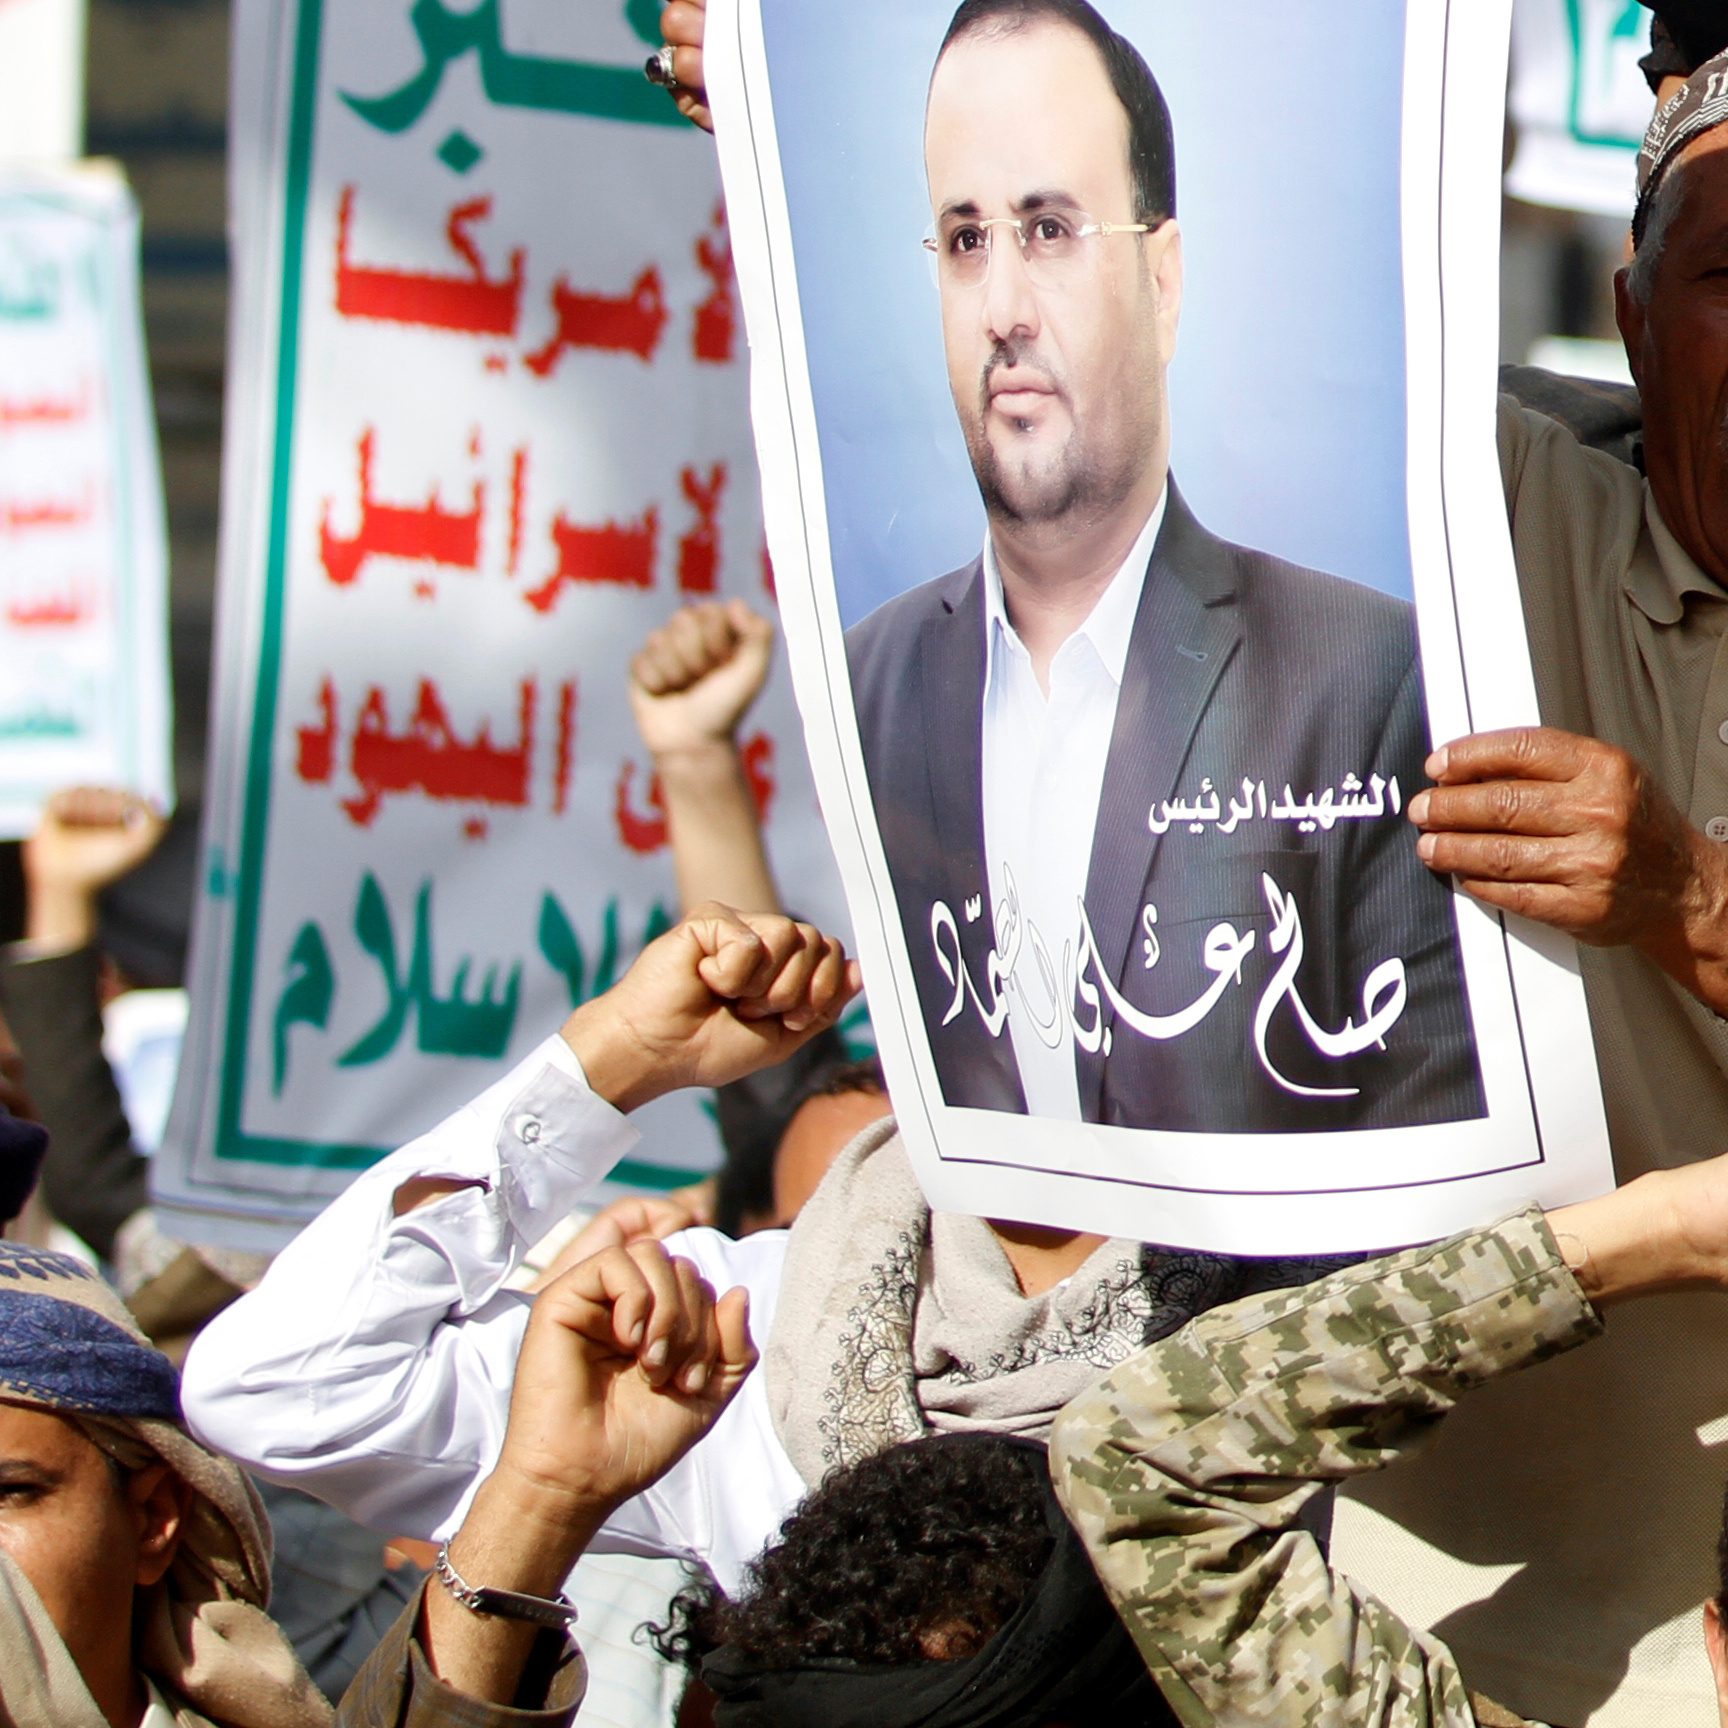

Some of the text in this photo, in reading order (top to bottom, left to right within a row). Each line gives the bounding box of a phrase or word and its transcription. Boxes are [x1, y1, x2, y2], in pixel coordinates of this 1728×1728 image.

[294, 670, 579, 843] اليهود
[1147, 771, 1402, 835] الشهيد الرئيس
[1253, 871, 1408, 1096] صالح
